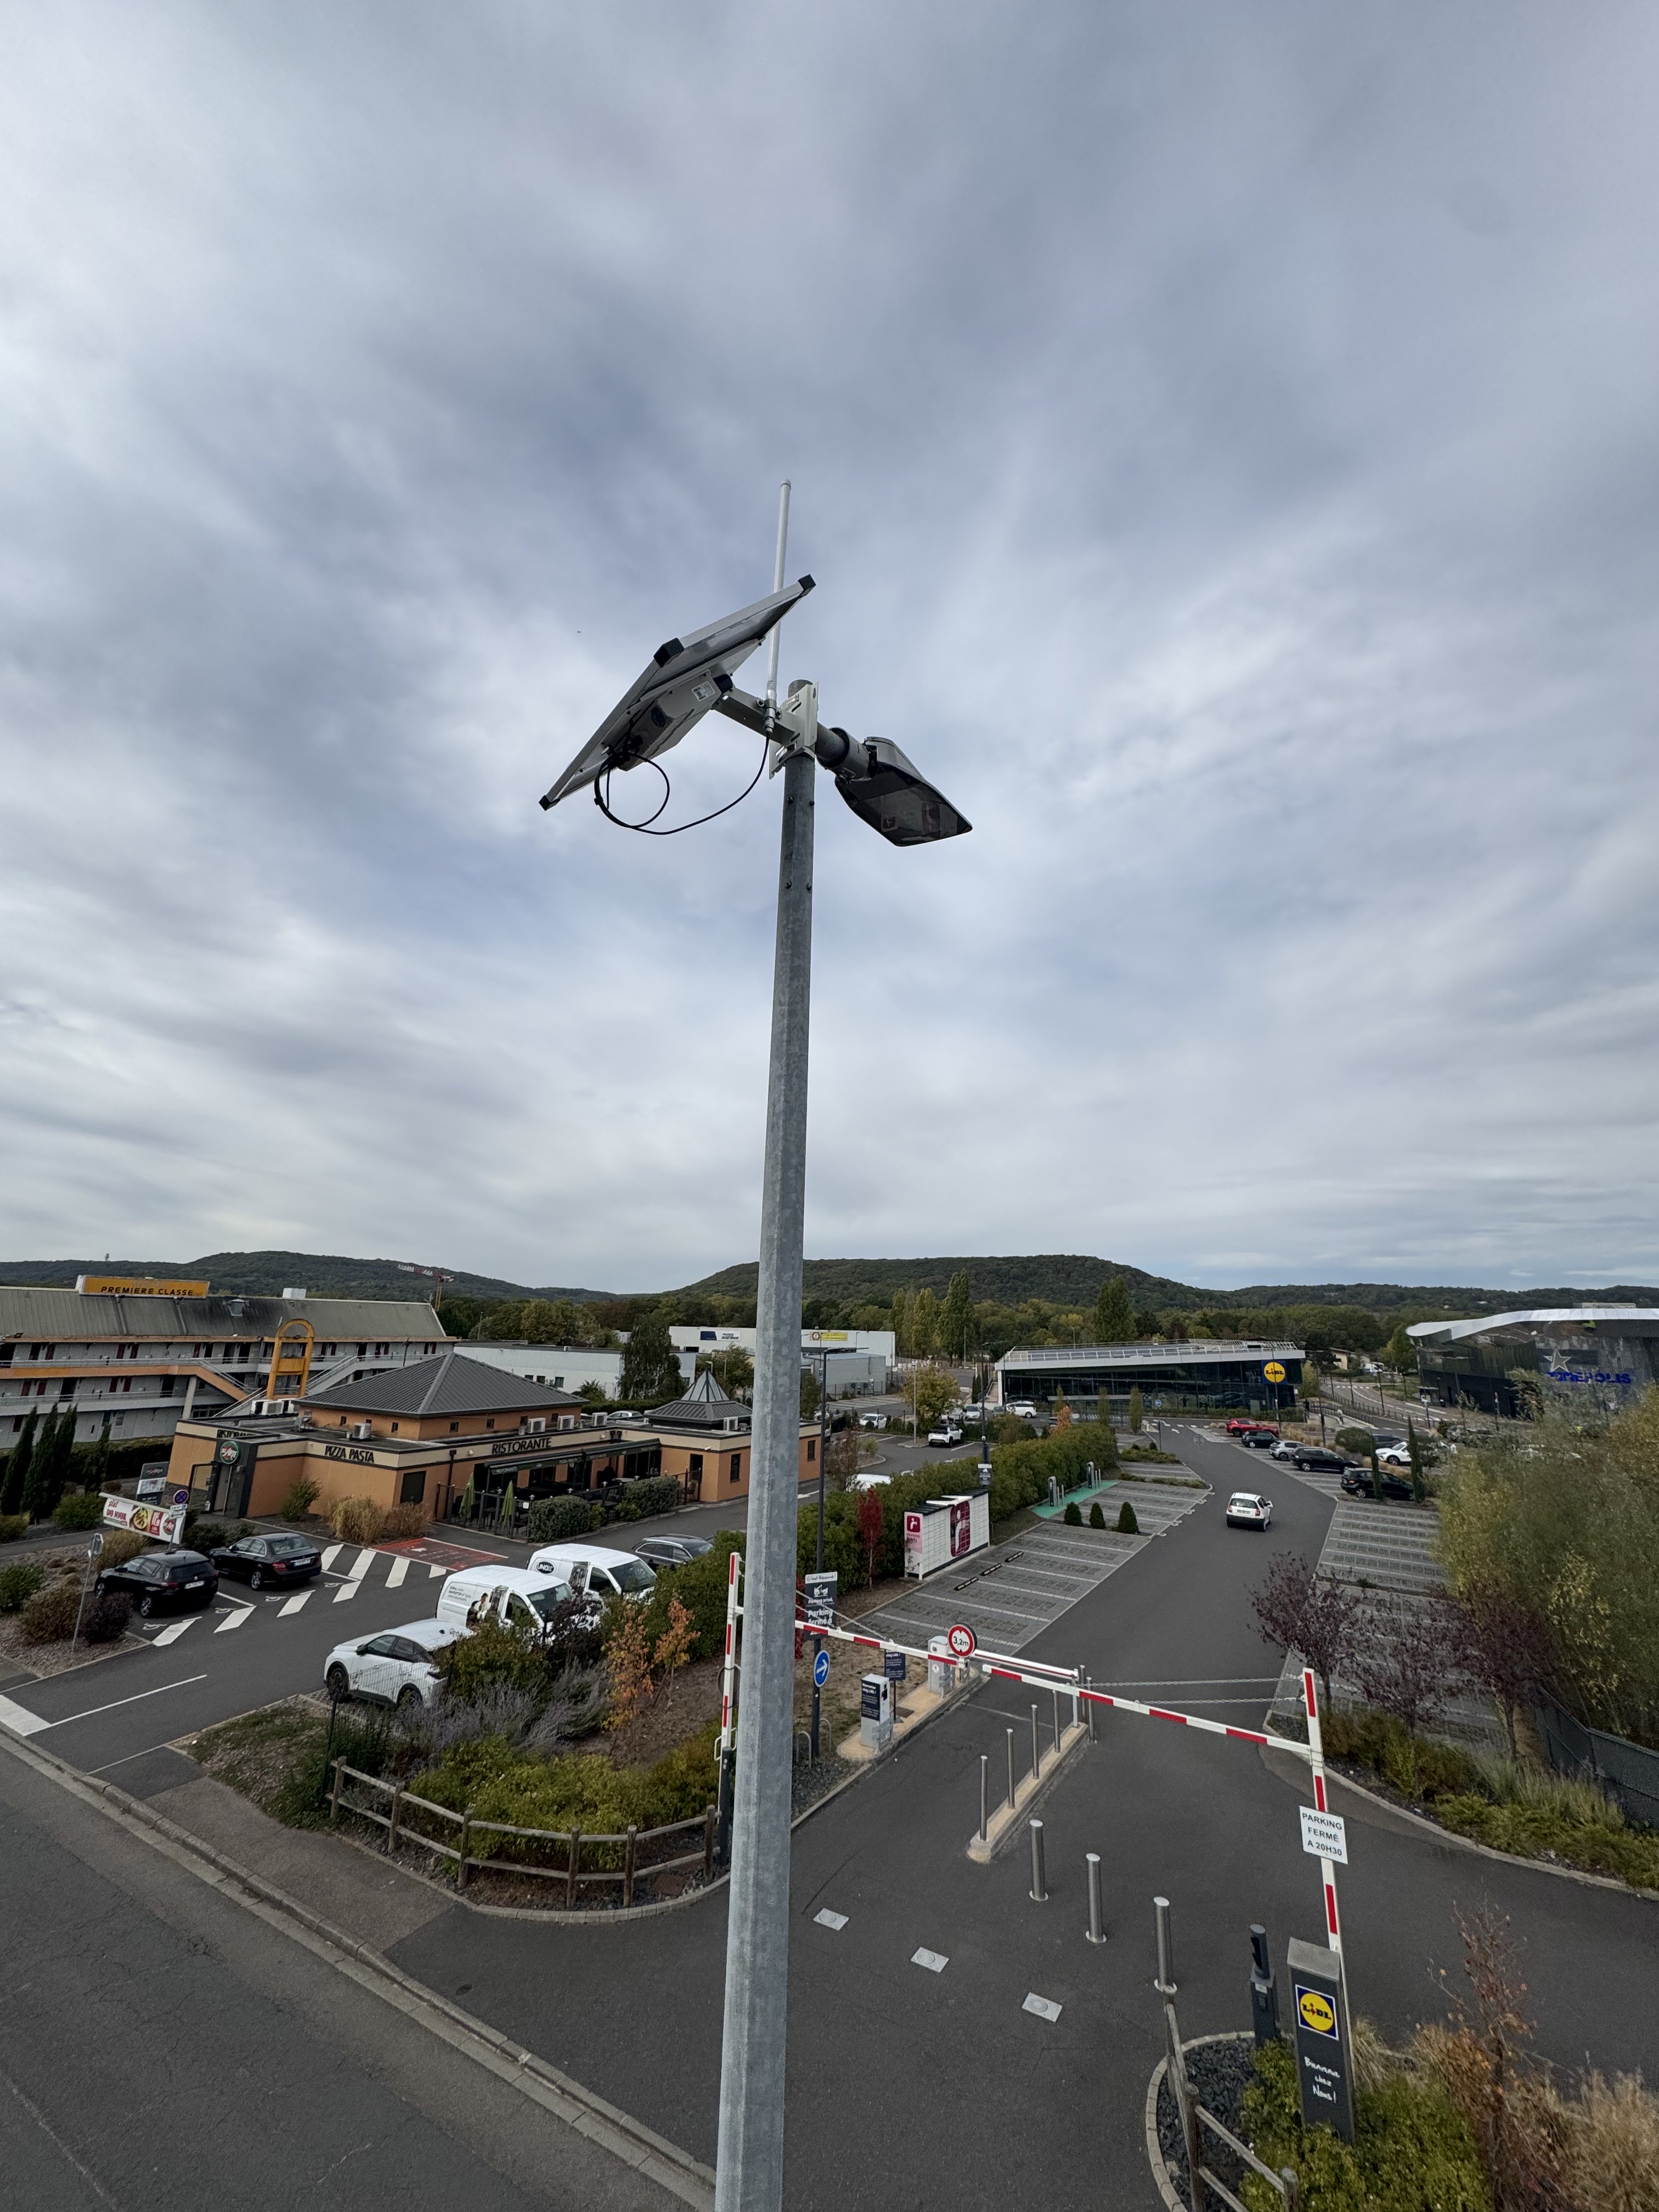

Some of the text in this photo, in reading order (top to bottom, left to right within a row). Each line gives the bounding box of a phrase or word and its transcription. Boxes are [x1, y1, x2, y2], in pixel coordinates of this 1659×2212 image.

[101, 1286, 154, 1295] PREMIERE
[492, 1437, 552, 1454] RISTORANTE
[325, 1445, 375, 1463] PIZZA PASTA
[808, 1608, 833, 1618] Parking
[953, 1636, 969, 1647] 3,2m
[1302, 1813, 1342, 1830] PARKING
[1308, 1826, 1339, 1842] FERMÉ
[1307, 1839, 1342, 1856] A 20H30
